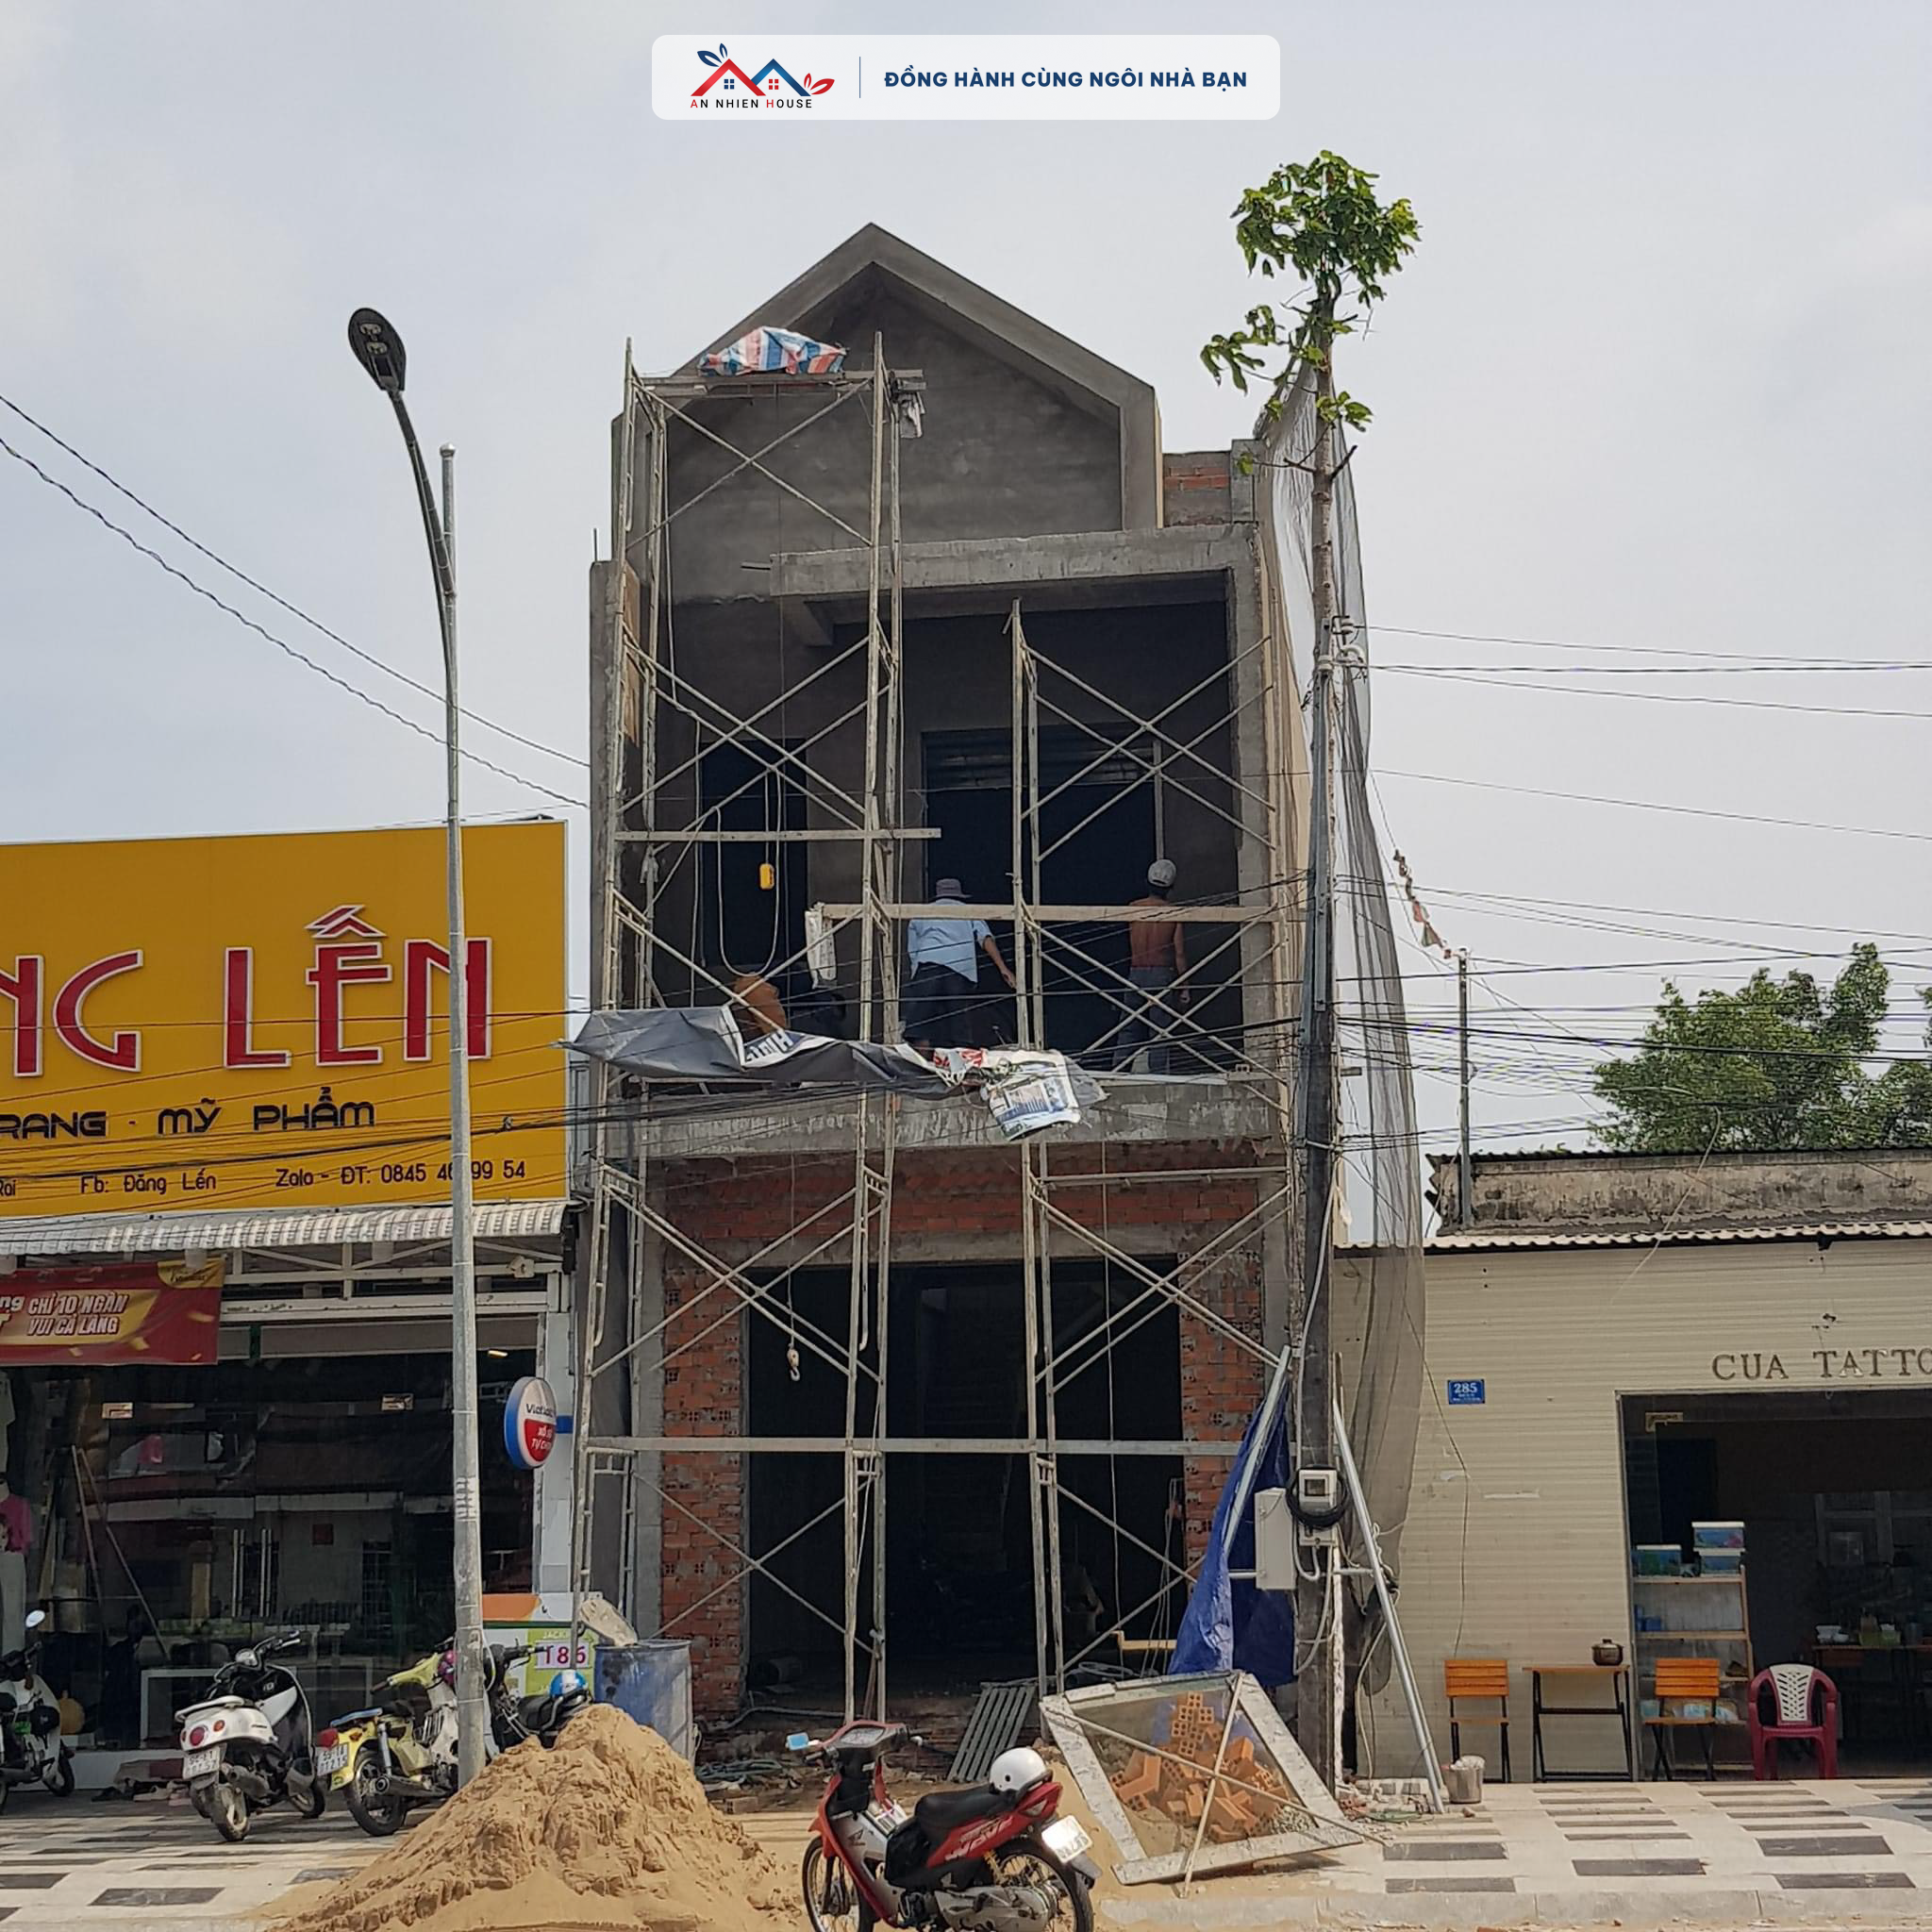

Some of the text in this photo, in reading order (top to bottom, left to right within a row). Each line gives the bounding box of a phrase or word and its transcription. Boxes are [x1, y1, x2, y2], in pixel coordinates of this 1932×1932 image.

[0, 1111, 108, 1139] RANG
[252, 1086, 375, 1131] PHẨM
[81, 1175, 109, 1193] Fb:
[275, 1169, 313, 1187] Zalo
[381, 1163, 425, 1183] 0845
[471, 1159, 493, 1179] 99
[503, 1159, 525, 1179] 54
[58, 1296, 79, 1314] 10
[28, 1318, 54, 1336] VUI
[1712, 1353, 1789, 1380] CUA
[1454, 1382, 1477, 1393] 285
